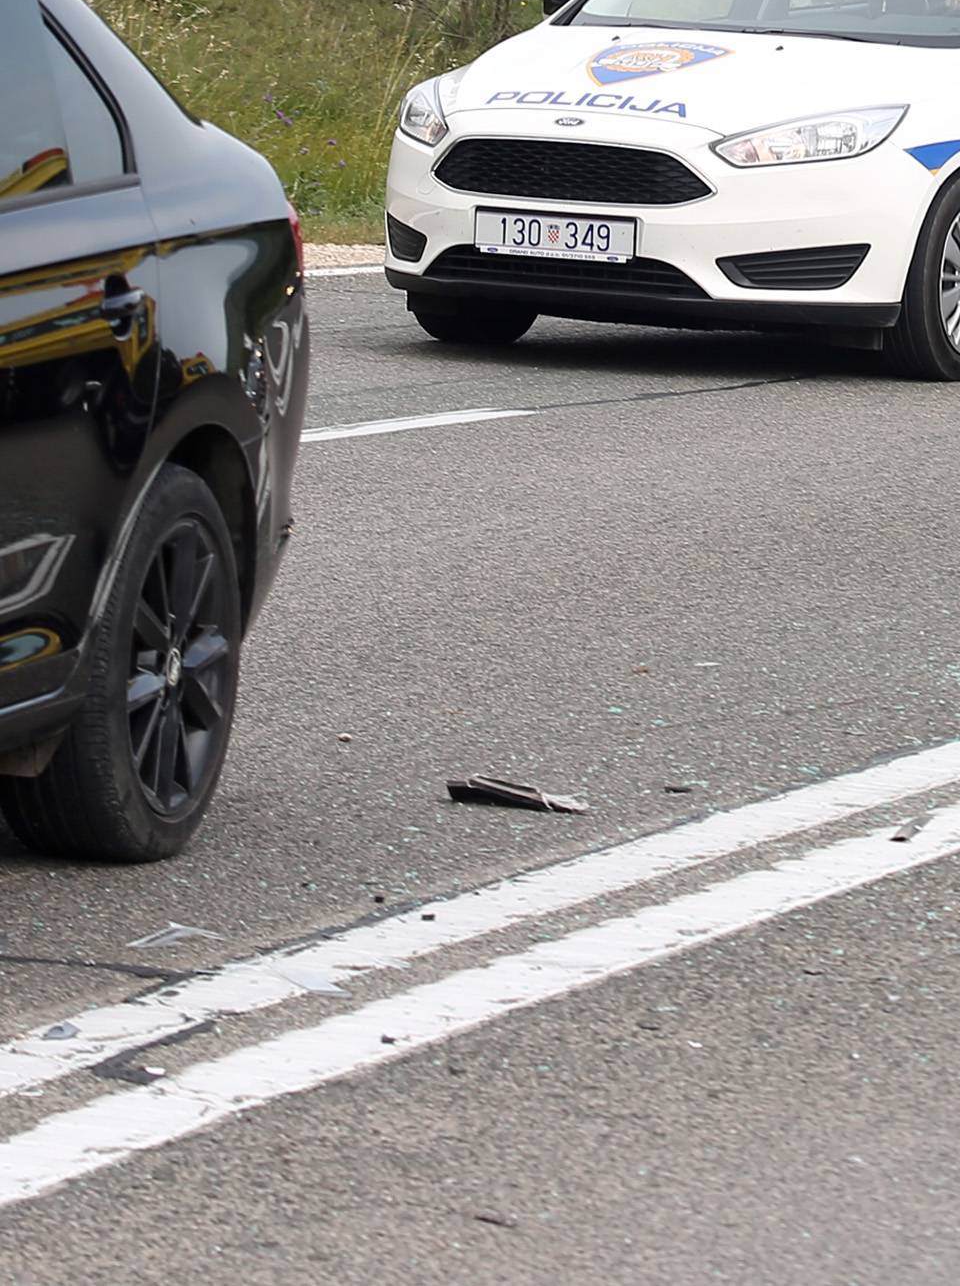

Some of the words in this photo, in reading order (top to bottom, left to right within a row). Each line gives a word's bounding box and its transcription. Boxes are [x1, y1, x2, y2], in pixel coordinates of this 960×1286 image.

[486, 91, 687, 118] POLICIJA
[502, 217, 542, 246] 130
[565, 222, 611, 251] 349
